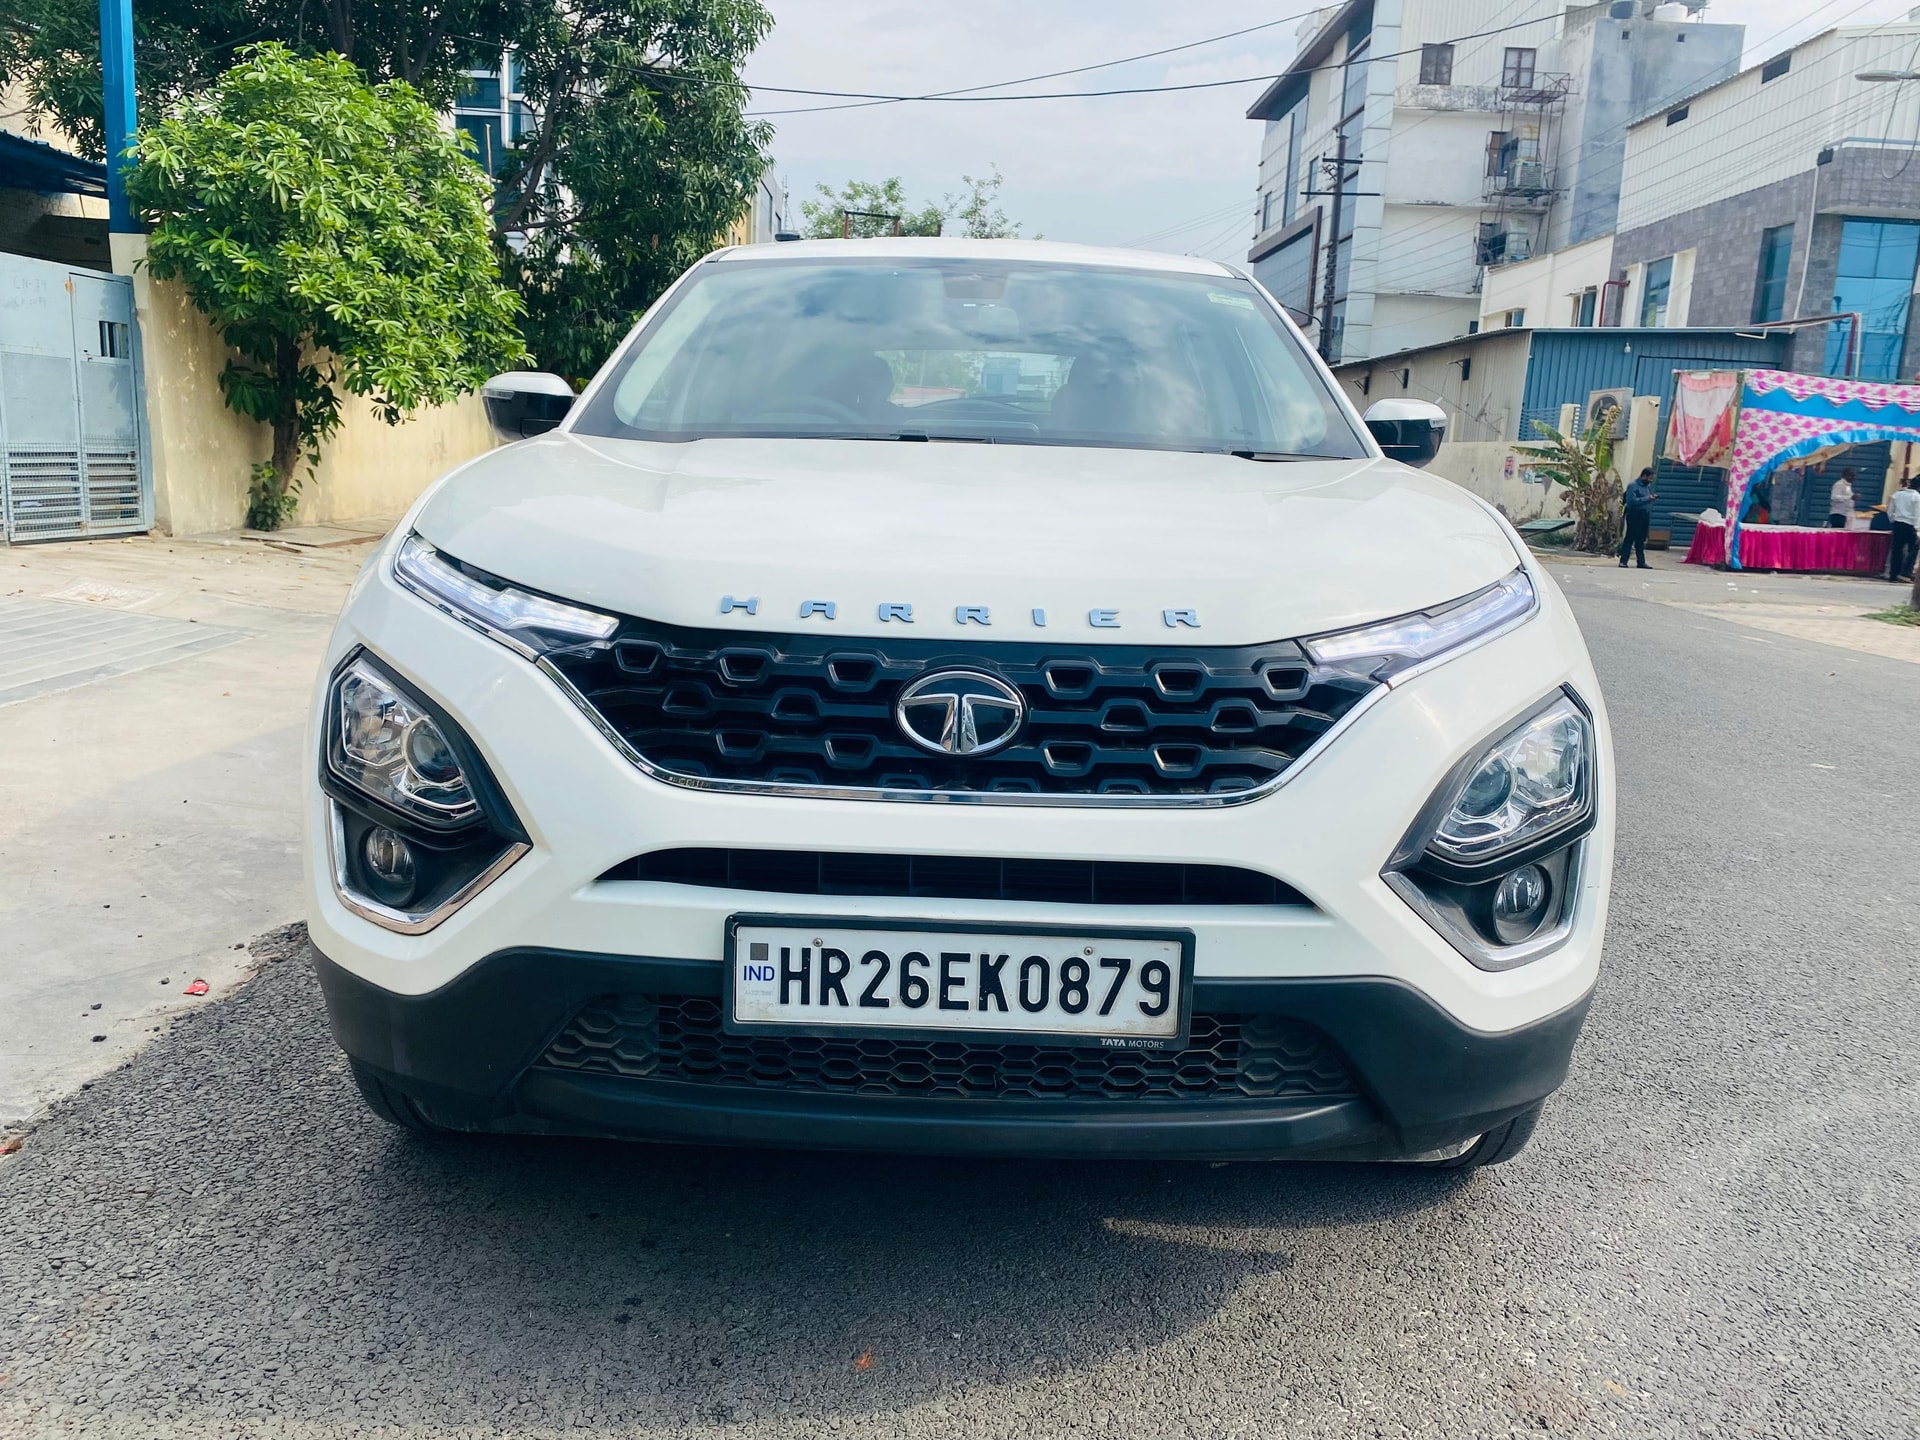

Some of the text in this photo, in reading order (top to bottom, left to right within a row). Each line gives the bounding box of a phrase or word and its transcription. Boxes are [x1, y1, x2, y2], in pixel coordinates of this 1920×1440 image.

[720, 595, 1200, 627] HARRIER
[743, 965, 775, 981] IND
[780, 947, 1171, 1017] HR26EK0879
[1100, 1038, 1164, 1049] TATA MOTORS
